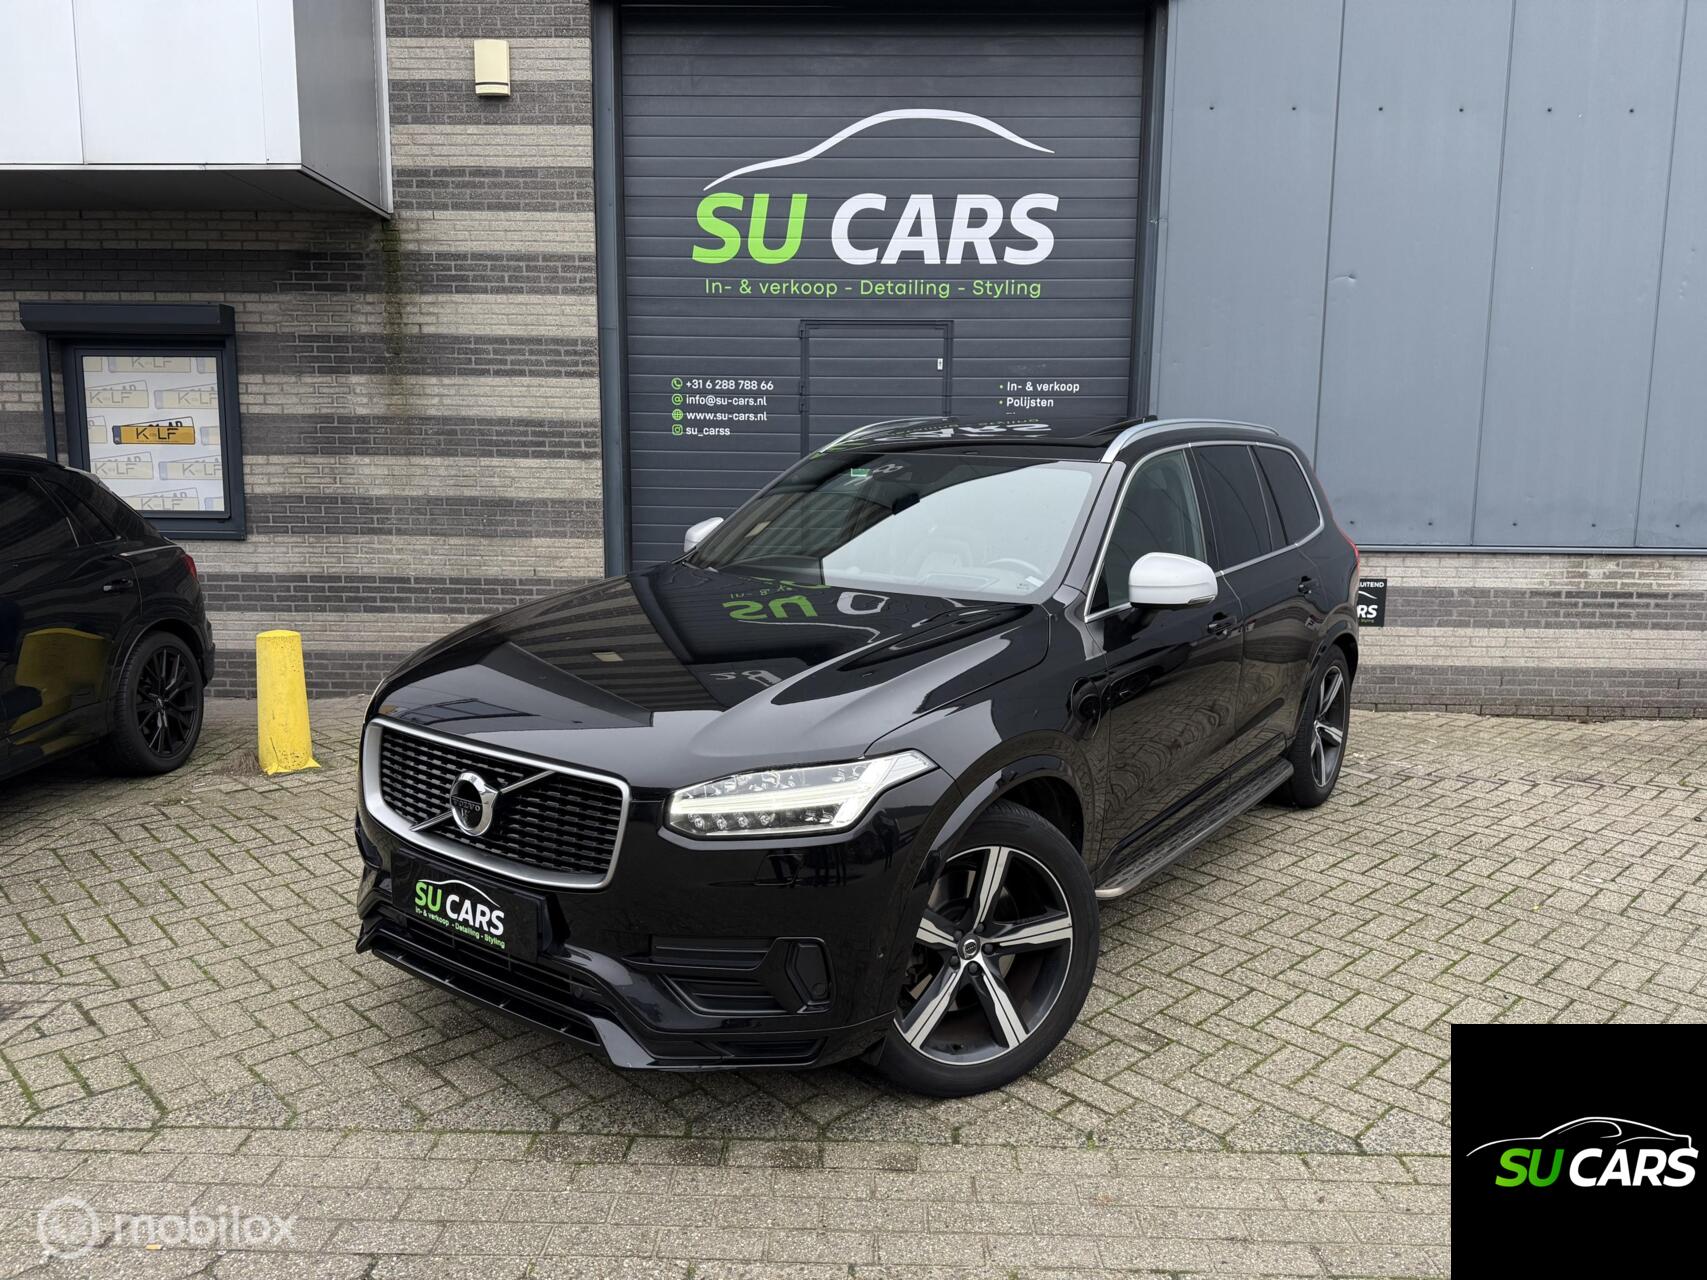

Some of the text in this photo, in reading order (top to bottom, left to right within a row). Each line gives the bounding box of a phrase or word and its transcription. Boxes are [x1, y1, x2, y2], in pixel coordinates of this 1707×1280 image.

[692, 192, 1060, 266] SU CARS
[705, 279, 732, 294] In-
[739, 279, 752, 294] &
[759, 279, 838, 298] verkoop
[860, 279, 950, 298] Detailing
[972, 279, 1041, 298] Styling
[685, 379, 774, 390] +31 6 288 788 66
[1007, 381, 1080, 394] In- & verkoop
[685, 394, 768, 406] info@su-cars.nl
[1006, 396, 1054, 409] Polijsten
[685, 411, 768, 421] www.su-cars.nl
[685, 427, 731, 437] su_carss
[415, 881, 505, 936] SU CARS
[428, 912, 450, 927] verkoop
[455, 922, 480, 940] Detailing
[484, 934, 506, 949] Styling
